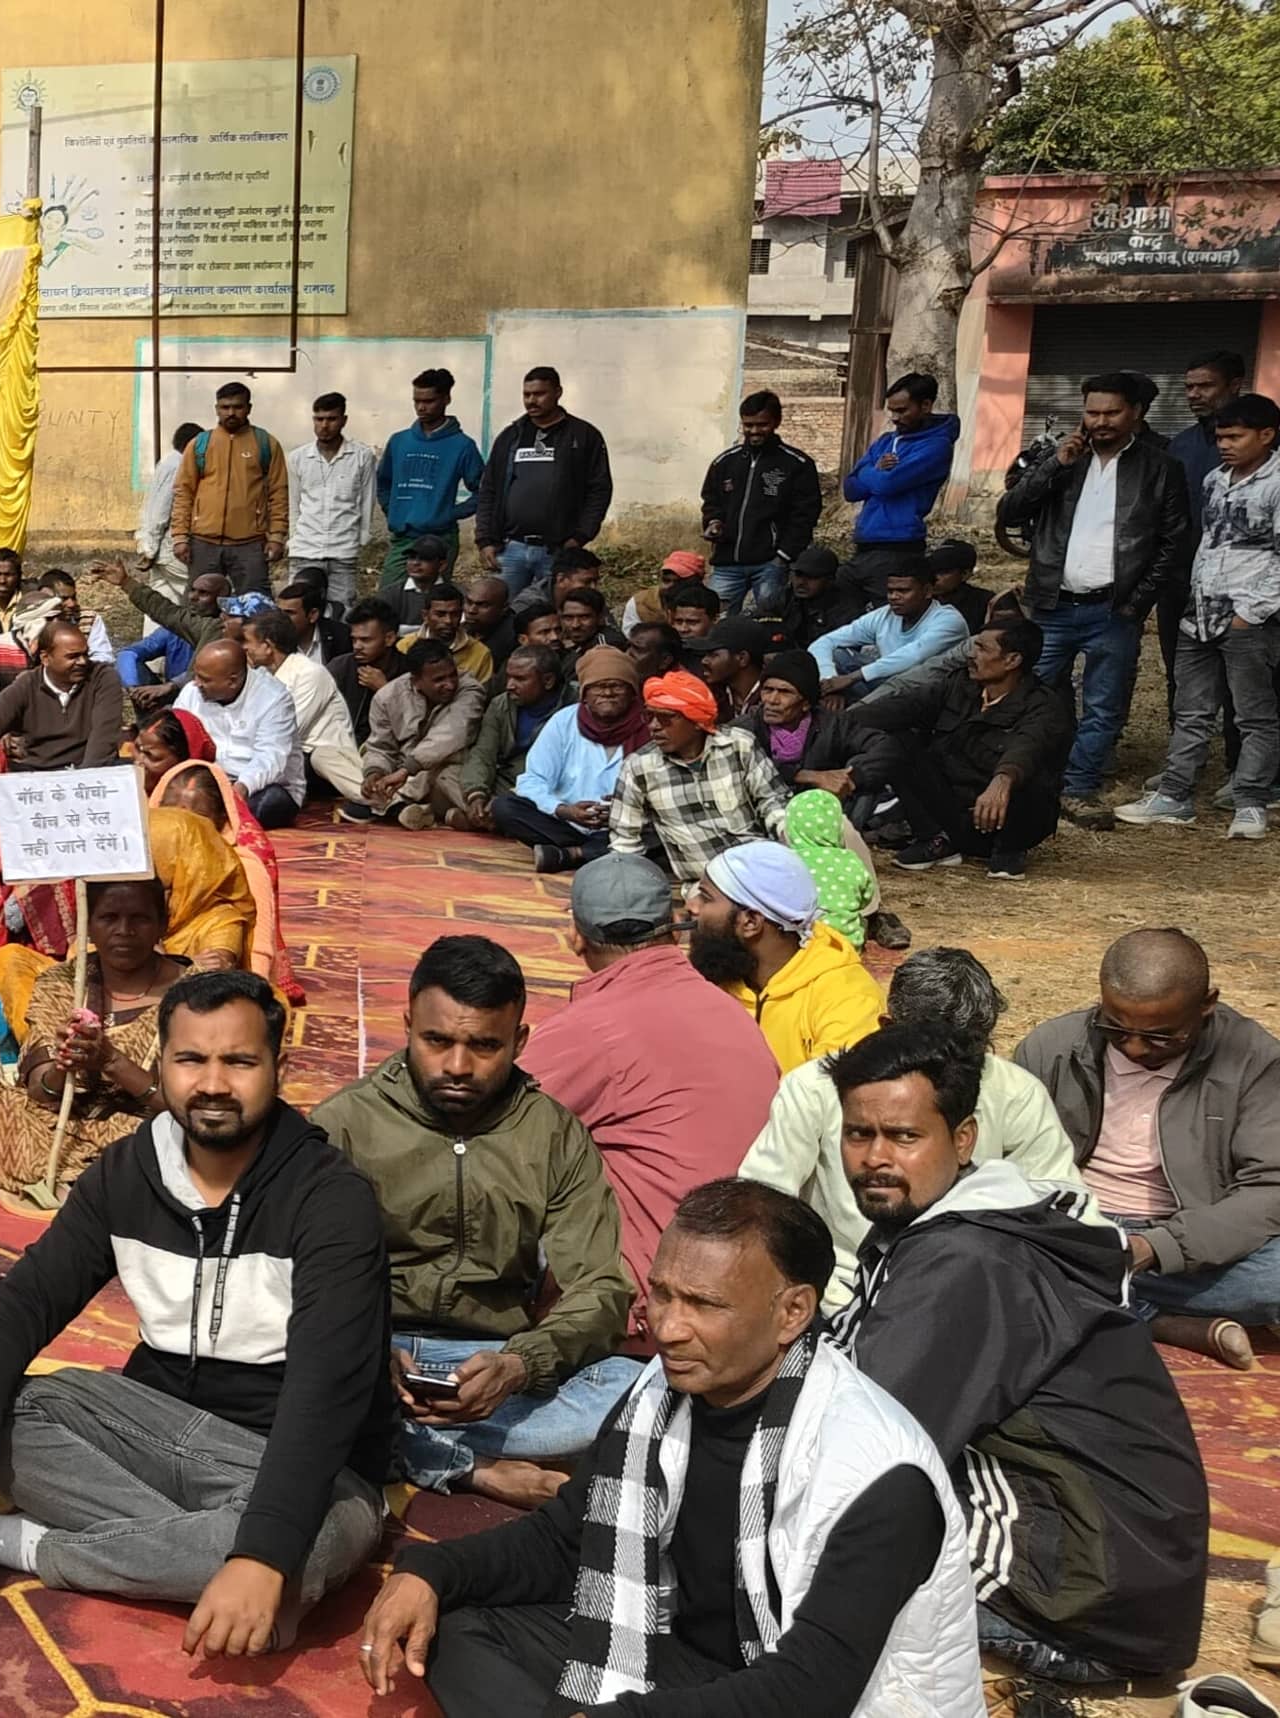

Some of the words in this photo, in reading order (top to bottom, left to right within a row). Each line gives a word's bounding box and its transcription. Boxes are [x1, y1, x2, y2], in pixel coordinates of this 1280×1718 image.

[49, 783, 67, 802] के
[30, 811, 59, 830] बीच
[64, 808, 81, 828] से
[86, 807, 112, 826] रेल
[55, 834, 87, 854] जाने
